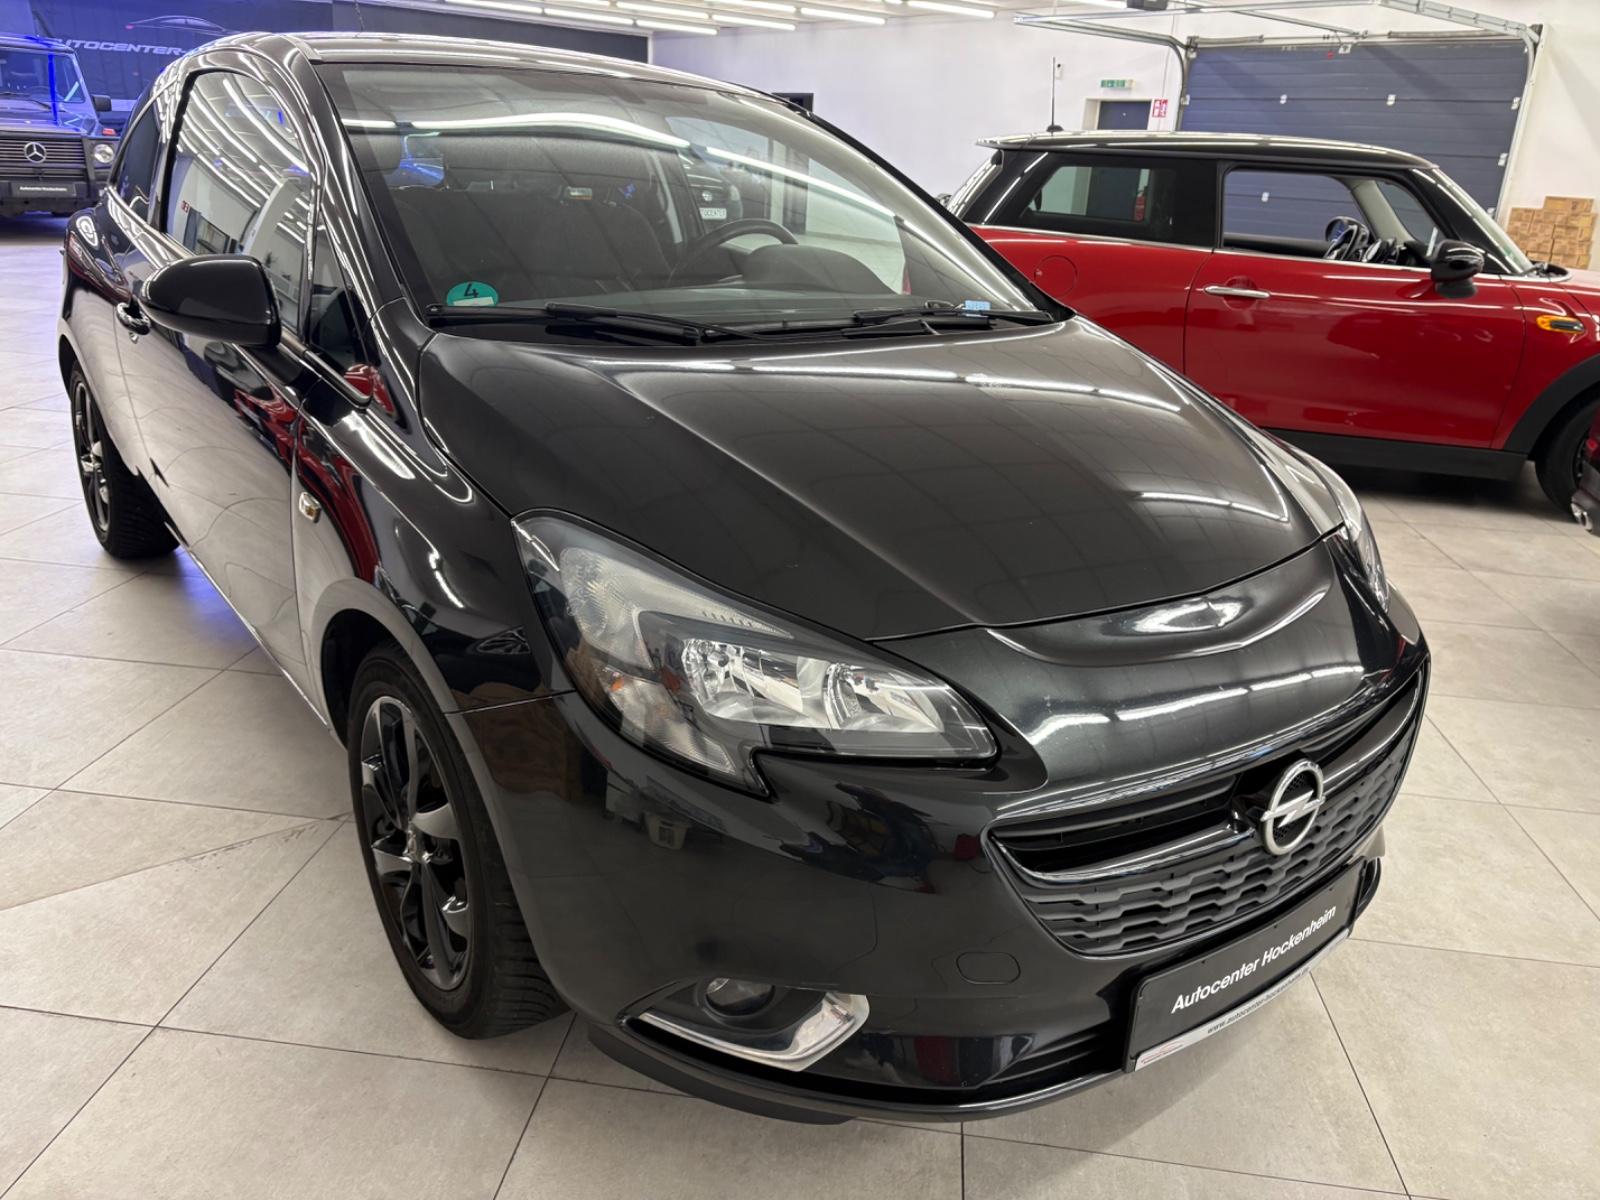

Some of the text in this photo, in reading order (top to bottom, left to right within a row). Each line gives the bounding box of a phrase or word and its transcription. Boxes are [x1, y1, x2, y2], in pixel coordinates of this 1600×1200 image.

[464, 283, 479, 298] 4
[1171, 906, 1336, 1014] Autocenter Hockenheim
